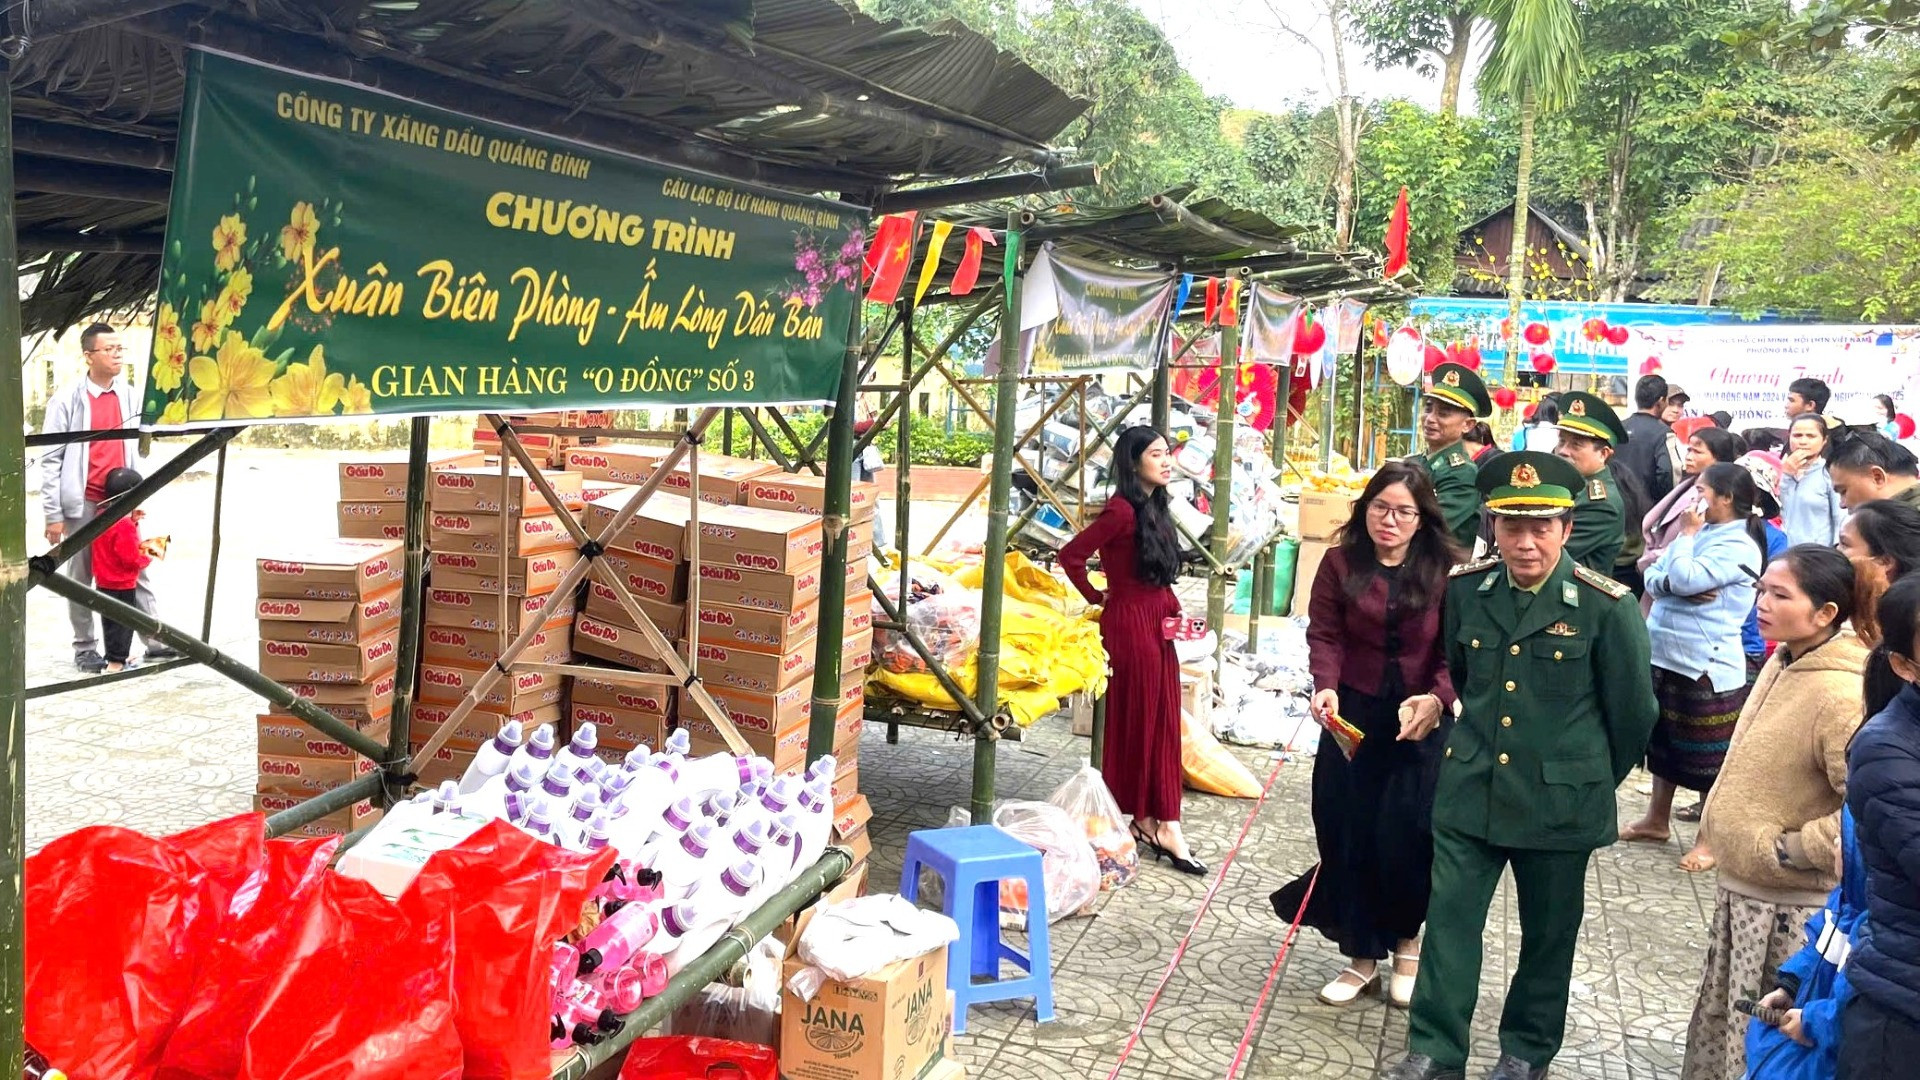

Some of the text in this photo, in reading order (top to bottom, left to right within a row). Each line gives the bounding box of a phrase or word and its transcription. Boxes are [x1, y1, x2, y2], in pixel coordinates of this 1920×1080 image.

[277, 90, 343, 129] CÔNG
[350, 106, 376, 135] TY
[380, 113, 439, 148] XĂNG
[487, 138, 548, 170] QUẢNG
[550, 151, 591, 179] BÌNH
[486, 191, 736, 260] CHƯƠNG TRÌNH
[690, 184, 715, 207] LẠC
[716, 188, 734, 212] BỘ
[750, 196, 780, 218] HÀNH
[781, 202, 815, 226] QUẢNG
[816, 209, 840, 230] BÌNH
[266, 246, 404, 331] Xuân
[416, 259, 500, 322] Biên
[509, 266, 602, 347] Phòng
[617, 256, 669, 345] Ấm
[670, 284, 728, 350] Lòng
[733, 290, 776, 337] Dân
[371, 365, 468, 398] GIAN
[476, 357, 568, 397] HÀNG
[619, 355, 704, 393] ĐỒNG”
[707, 358, 740, 393] SỐ
[742, 369, 755, 392] 3
[801, 1003, 865, 1036] JANA
[904, 976, 933, 1024] JANA
